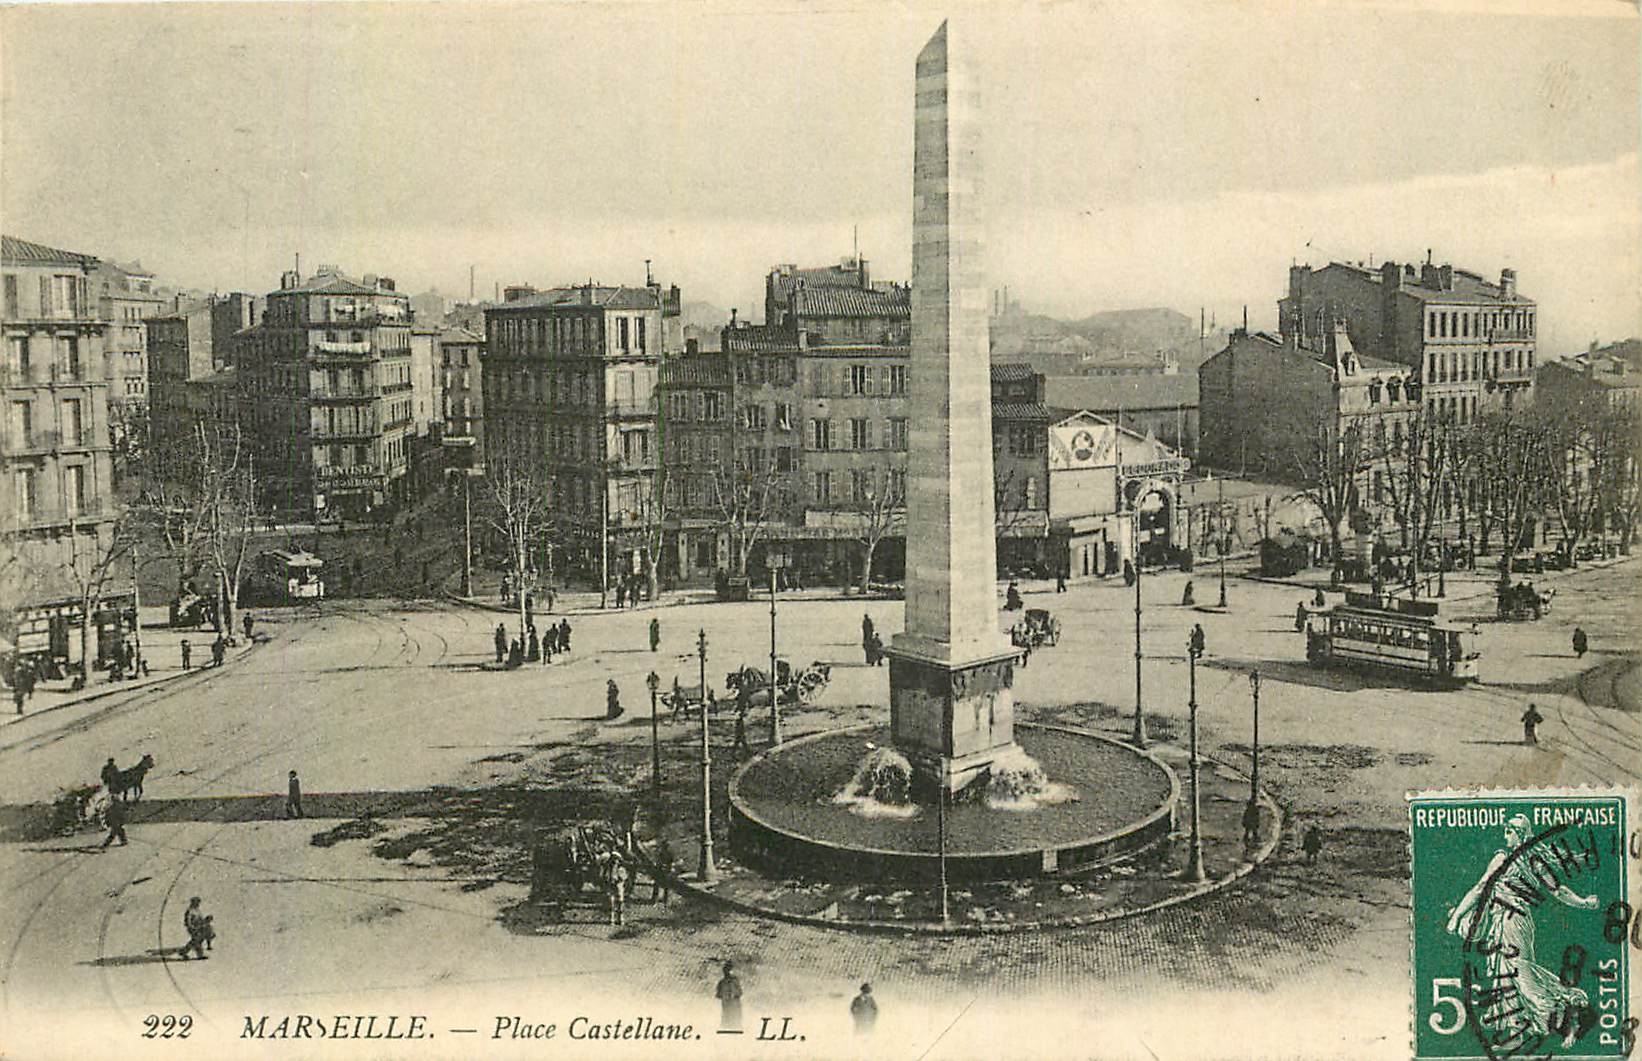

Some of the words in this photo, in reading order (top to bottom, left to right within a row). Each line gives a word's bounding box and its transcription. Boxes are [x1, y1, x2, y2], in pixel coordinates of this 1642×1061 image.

[1416, 808, 1506, 830] REPUBLIQUE
[1533, 807, 1616, 829] FRANÇAISE
[1599, 958, 1618, 1045] POSTES
